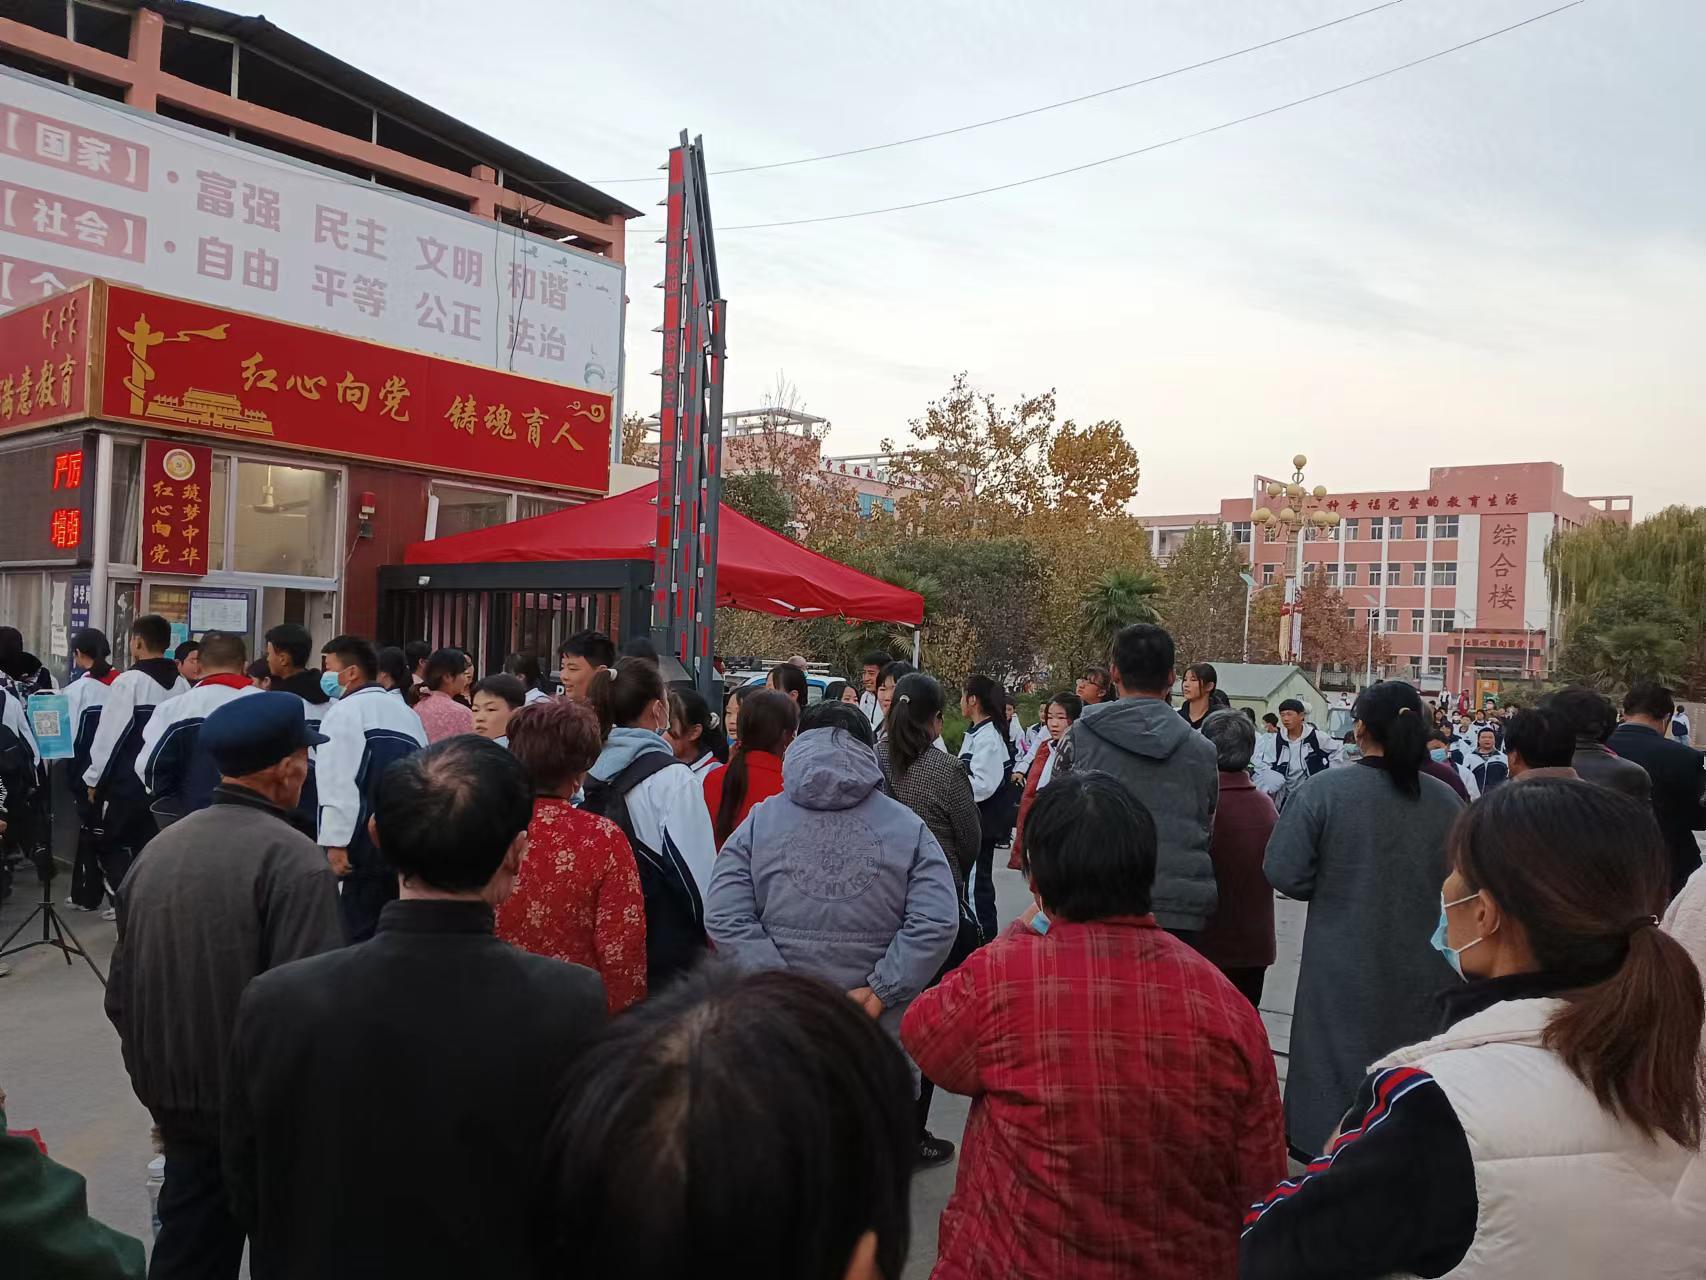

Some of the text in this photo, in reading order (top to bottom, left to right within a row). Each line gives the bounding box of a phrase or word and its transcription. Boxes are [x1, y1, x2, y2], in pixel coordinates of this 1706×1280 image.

[196, 169, 281, 232] 富强
[314, 203, 388, 261] 民主
[415, 235, 483, 288] 文明
[507, 260, 569, 312] 和谐
[197, 236, 280, 291] 自由
[311, 264, 387, 318] 平等
[415, 291, 482, 342] 公正
[506, 314, 567, 362] 法治
[240, 351, 585, 451] 红心向党 铸魂育人
[150, 480, 174, 564] 红心向党
[178, 483, 202, 567] 筑梦中华
[1487, 523, 1518, 610] 综合楼
